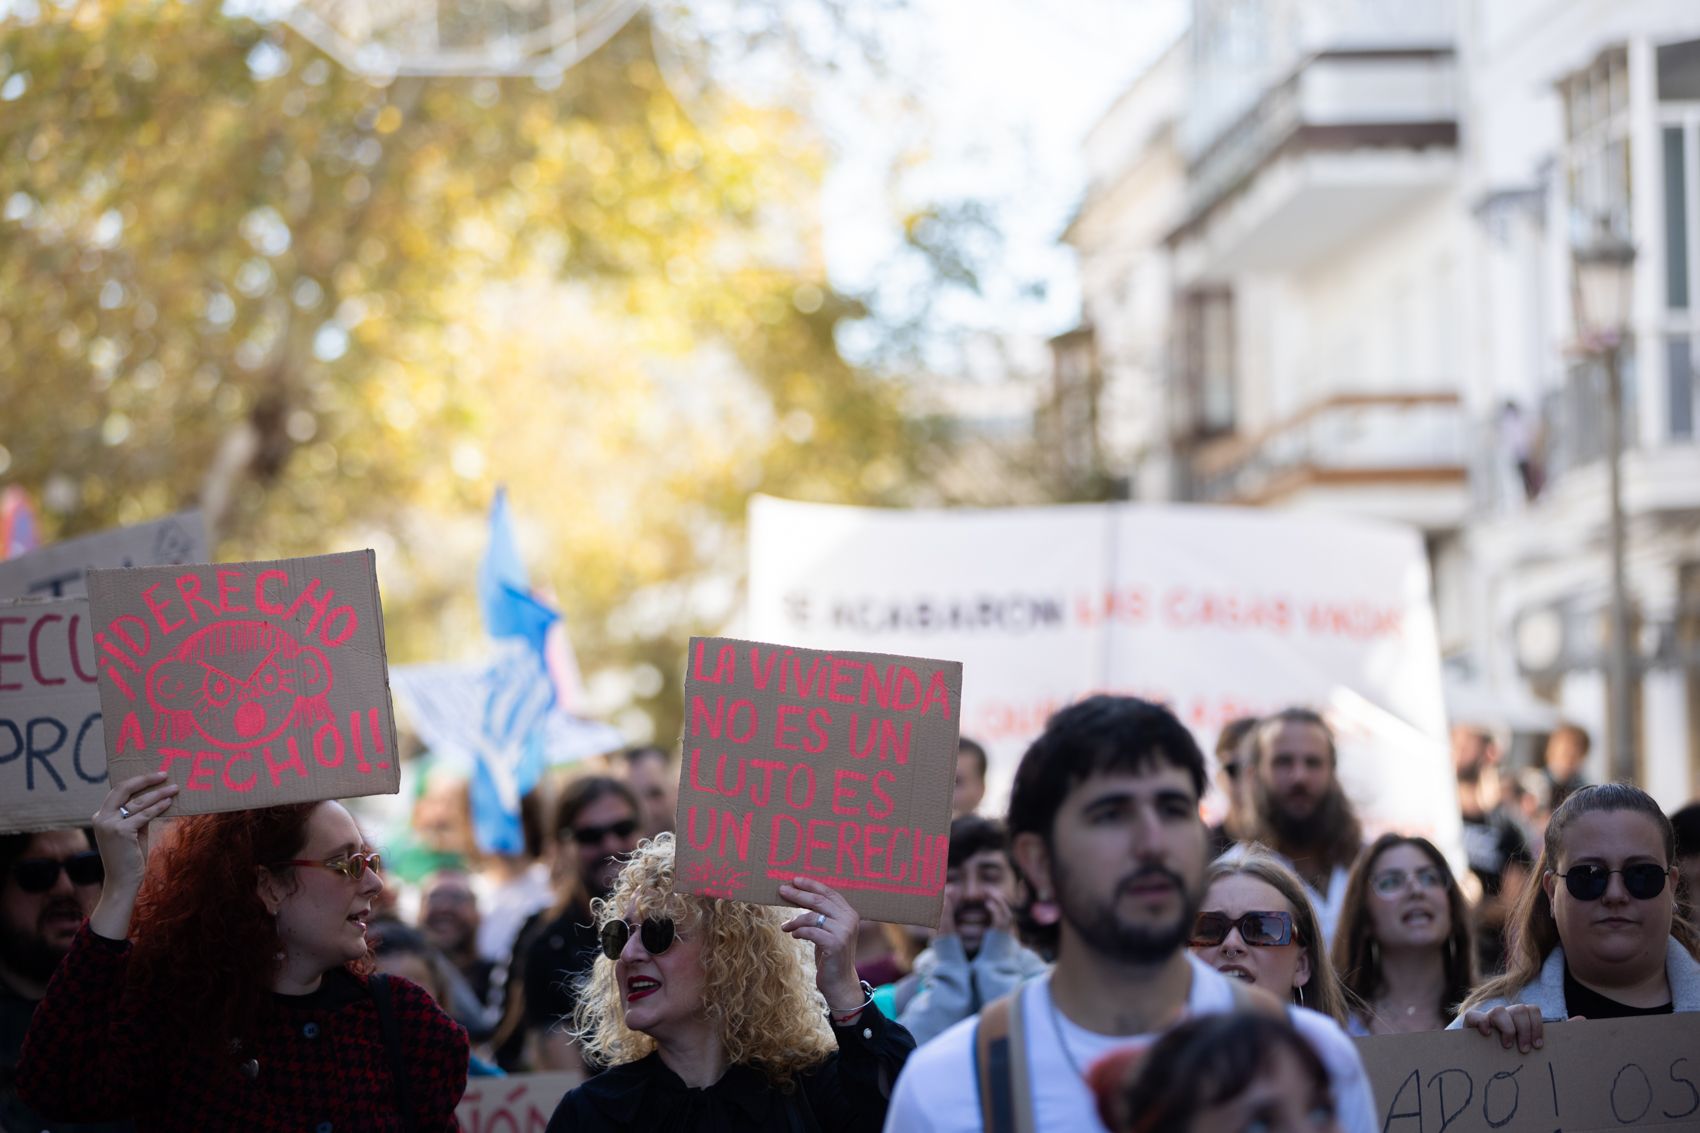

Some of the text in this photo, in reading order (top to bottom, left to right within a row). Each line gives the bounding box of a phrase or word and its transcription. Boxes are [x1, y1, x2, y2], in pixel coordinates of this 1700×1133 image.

[692, 639, 737, 686] LA
[748, 645, 952, 721] VIVIENDA
[115, 711, 148, 754] A
[690, 694, 759, 745] NO
[773, 703, 833, 754] ES
[848, 711, 913, 766] UN
[688, 747, 898, 821] LUJO ES
[686, 804, 949, 889] UN DERECHO
